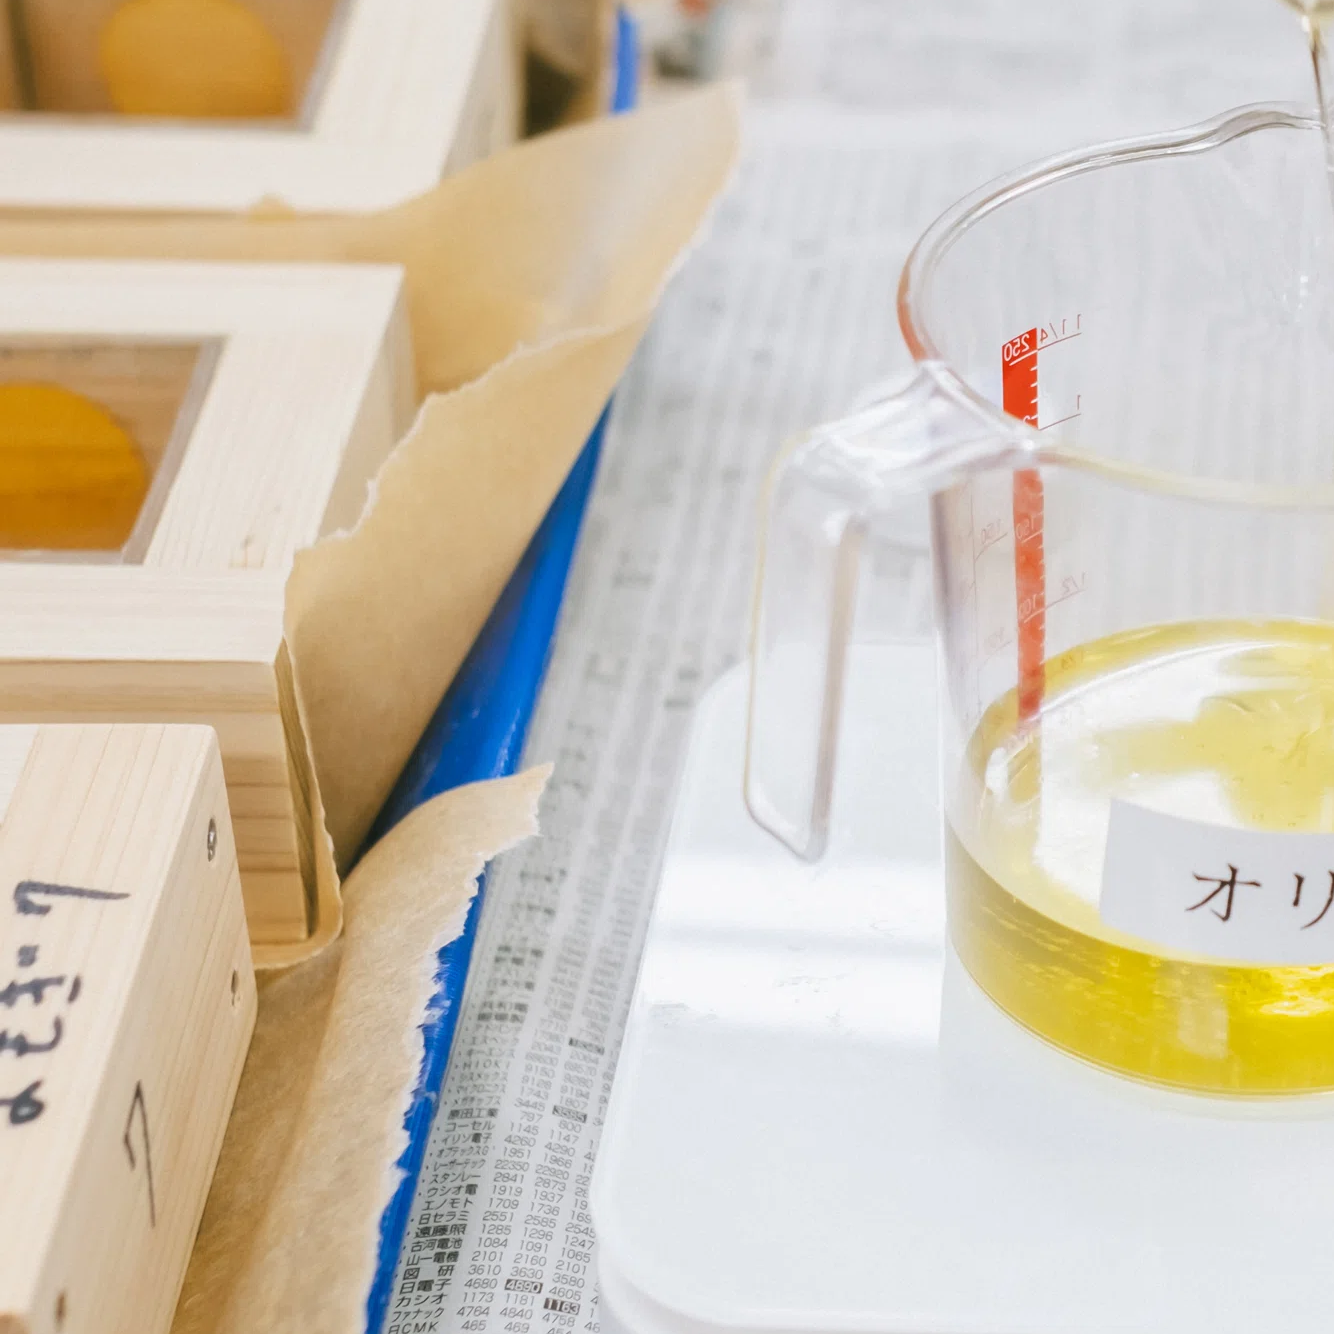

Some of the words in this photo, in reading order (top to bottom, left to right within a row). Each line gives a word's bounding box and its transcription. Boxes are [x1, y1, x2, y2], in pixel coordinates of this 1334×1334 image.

[445, 1120, 495, 1132] コーセル
[510, 1122, 539, 1135] 1145
[550, 1130, 579, 1144] 1147
[442, 1133, 492, 1145] イリソ電子
[504, 1134, 536, 1147] 4260
[545, 1142, 575, 1157] 4290
[503, 1147, 531, 1159] 1951
[494, 1159, 530, 1172] 22350
[535, 1164, 570, 1180] 22920
[430, 1172, 481, 1184] スタンレー
[493, 1173, 524, 1183] 2841
[535, 1177, 566, 1192] 2873
[427, 1184, 478, 1197] ウシオ電
[493, 1185, 523, 1196] 1919
[534, 1190, 564, 1204] 1937
[422, 1198, 473, 1211] エノモト
[488, 1198, 519, 1209] 1709
[530, 1202, 560, 1216] 1736
[418, 1211, 470, 1225] 日セラミ
[482, 1211, 513, 1222] 2551
[524, 1215, 557, 1229] 2585
[565, 1223, 597, 1238] 2545
[481, 1224, 512, 1236] 1285
[523, 1227, 553, 1241] 1296
[565, 1235, 595, 1250] 1247
[411, 1238, 463, 1252] 古河電池
[477, 1238, 508, 1249] 1084
[520, 1240, 548, 1253] 1091
[561, 1248, 591, 1263] 1065
[407, 1251, 459, 1266] 山一電機
[472, 1251, 503, 1262] 2101
[514, 1253, 547, 1266] 2160
[555, 1259, 587, 1275] 2101
[468, 1265, 501, 1276] 3610
[510, 1267, 543, 1280] 3630
[552, 1273, 585, 1288] 3580
[401, 1279, 452, 1296] 日電子
[464, 1279, 498, 1289] 4680
[549, 1287, 582, 1301] 4605
[395, 1292, 448, 1308] カシオ
[462, 1292, 494, 1303] 1173
[505, 1294, 536, 1306] 1181
[543, 1298, 580, 1315] 1163
[392, 1307, 445, 1322] ファナック
[456, 1306, 490, 1317] 4764
[500, 1308, 533, 1320] 4840
[542, 1313, 576, 1328] 4758
